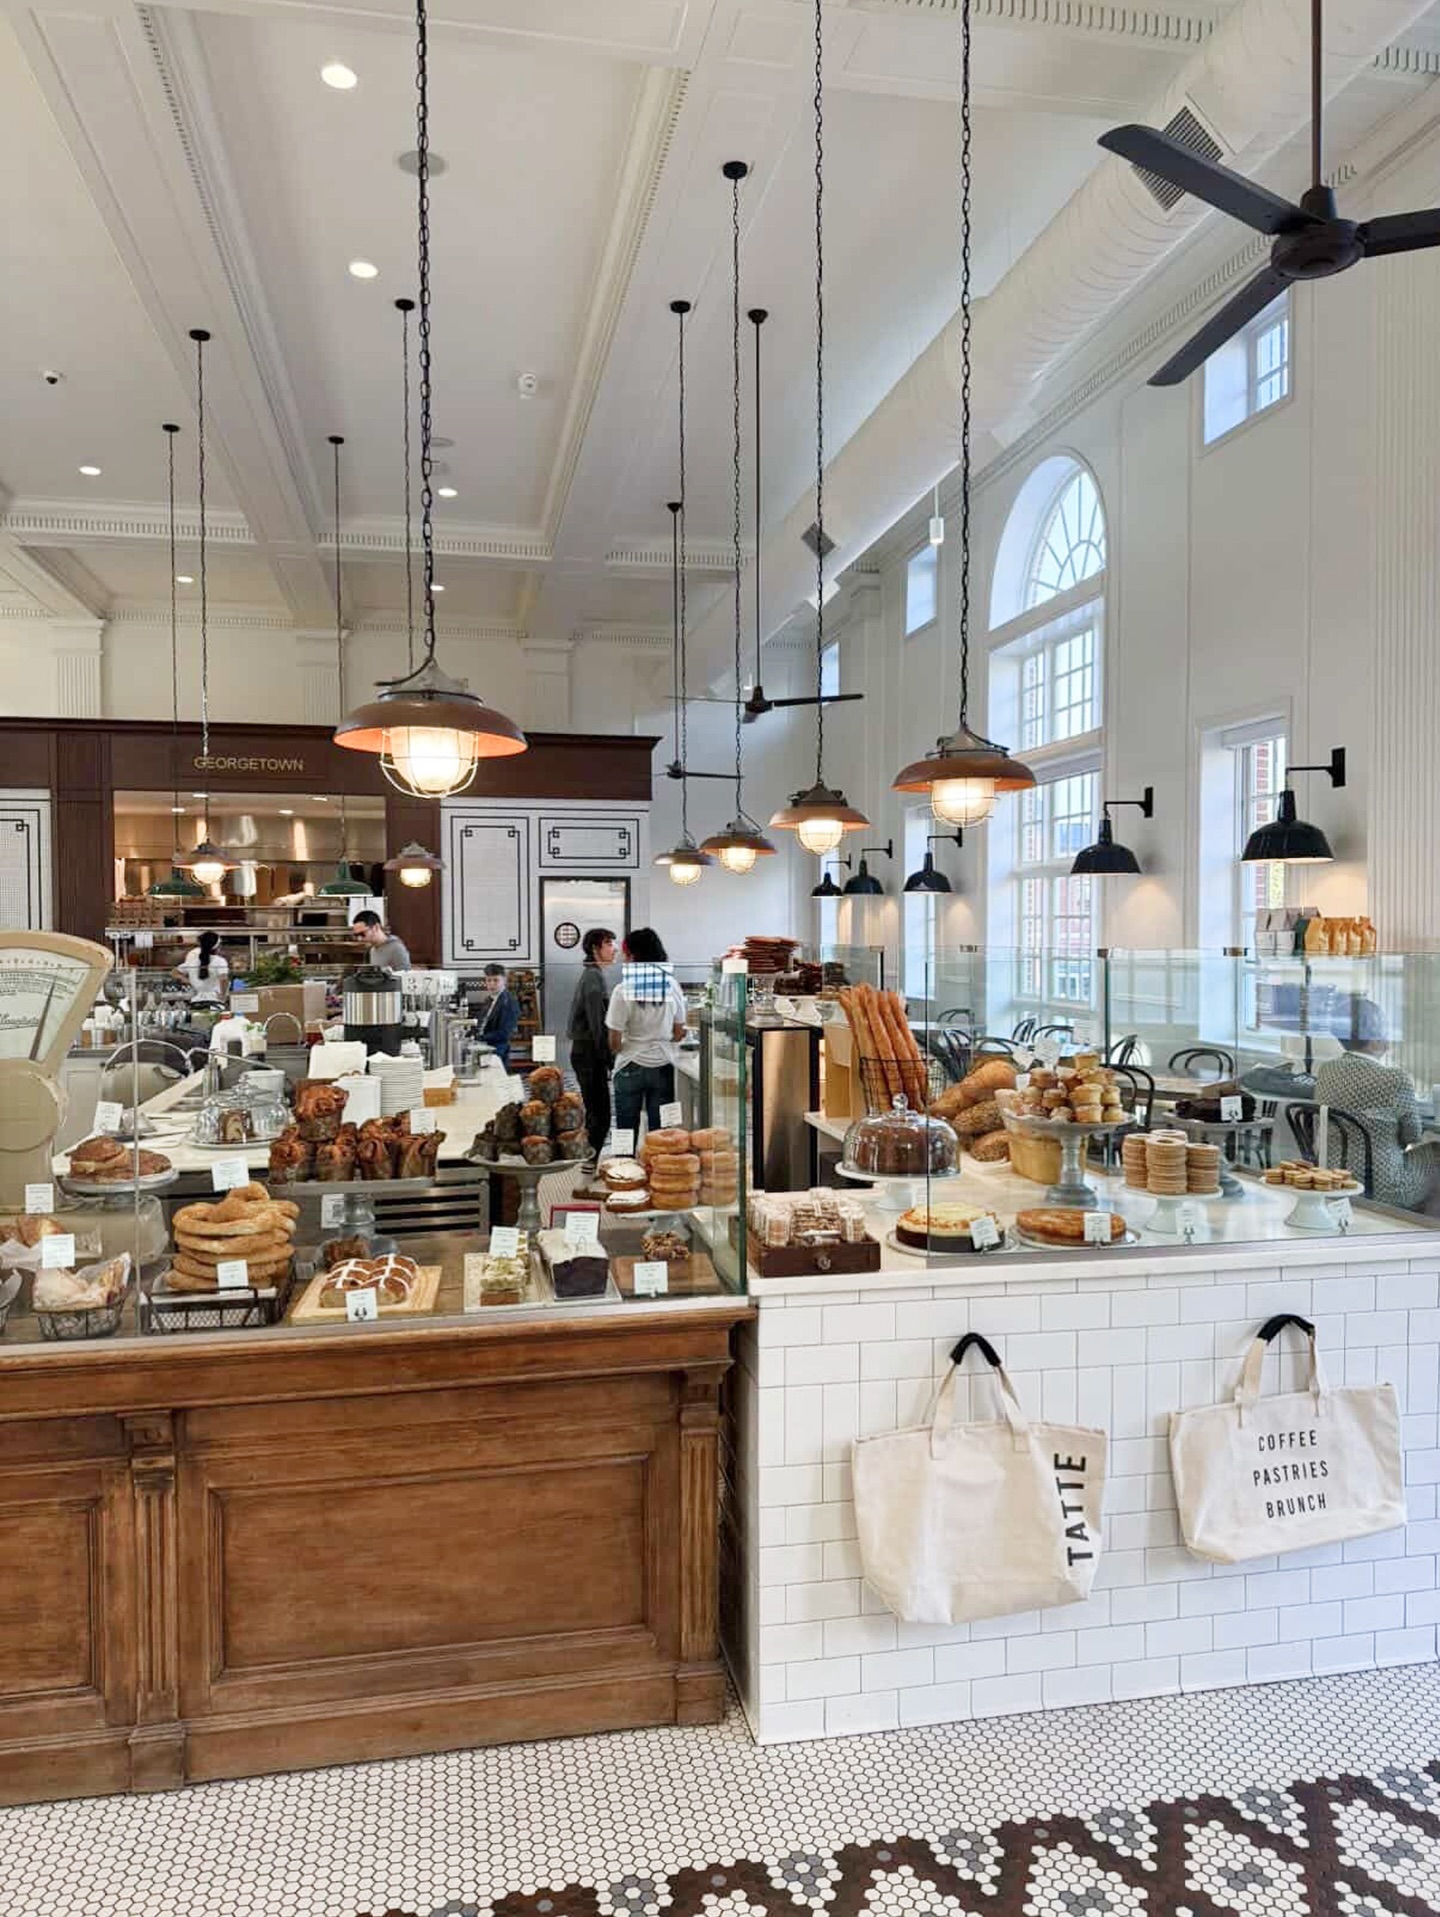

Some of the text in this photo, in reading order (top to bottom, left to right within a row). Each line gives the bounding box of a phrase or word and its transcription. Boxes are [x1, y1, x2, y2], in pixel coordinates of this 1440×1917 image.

[194, 757, 304, 771] GEORGETOWN
[1258, 1430, 1318, 1452] COFFEE
[1253, 1460, 1329, 1486] PASTRIES
[1054, 1453, 1093, 1567] TATTE
[1266, 1493, 1327, 1519] BRUNCH
